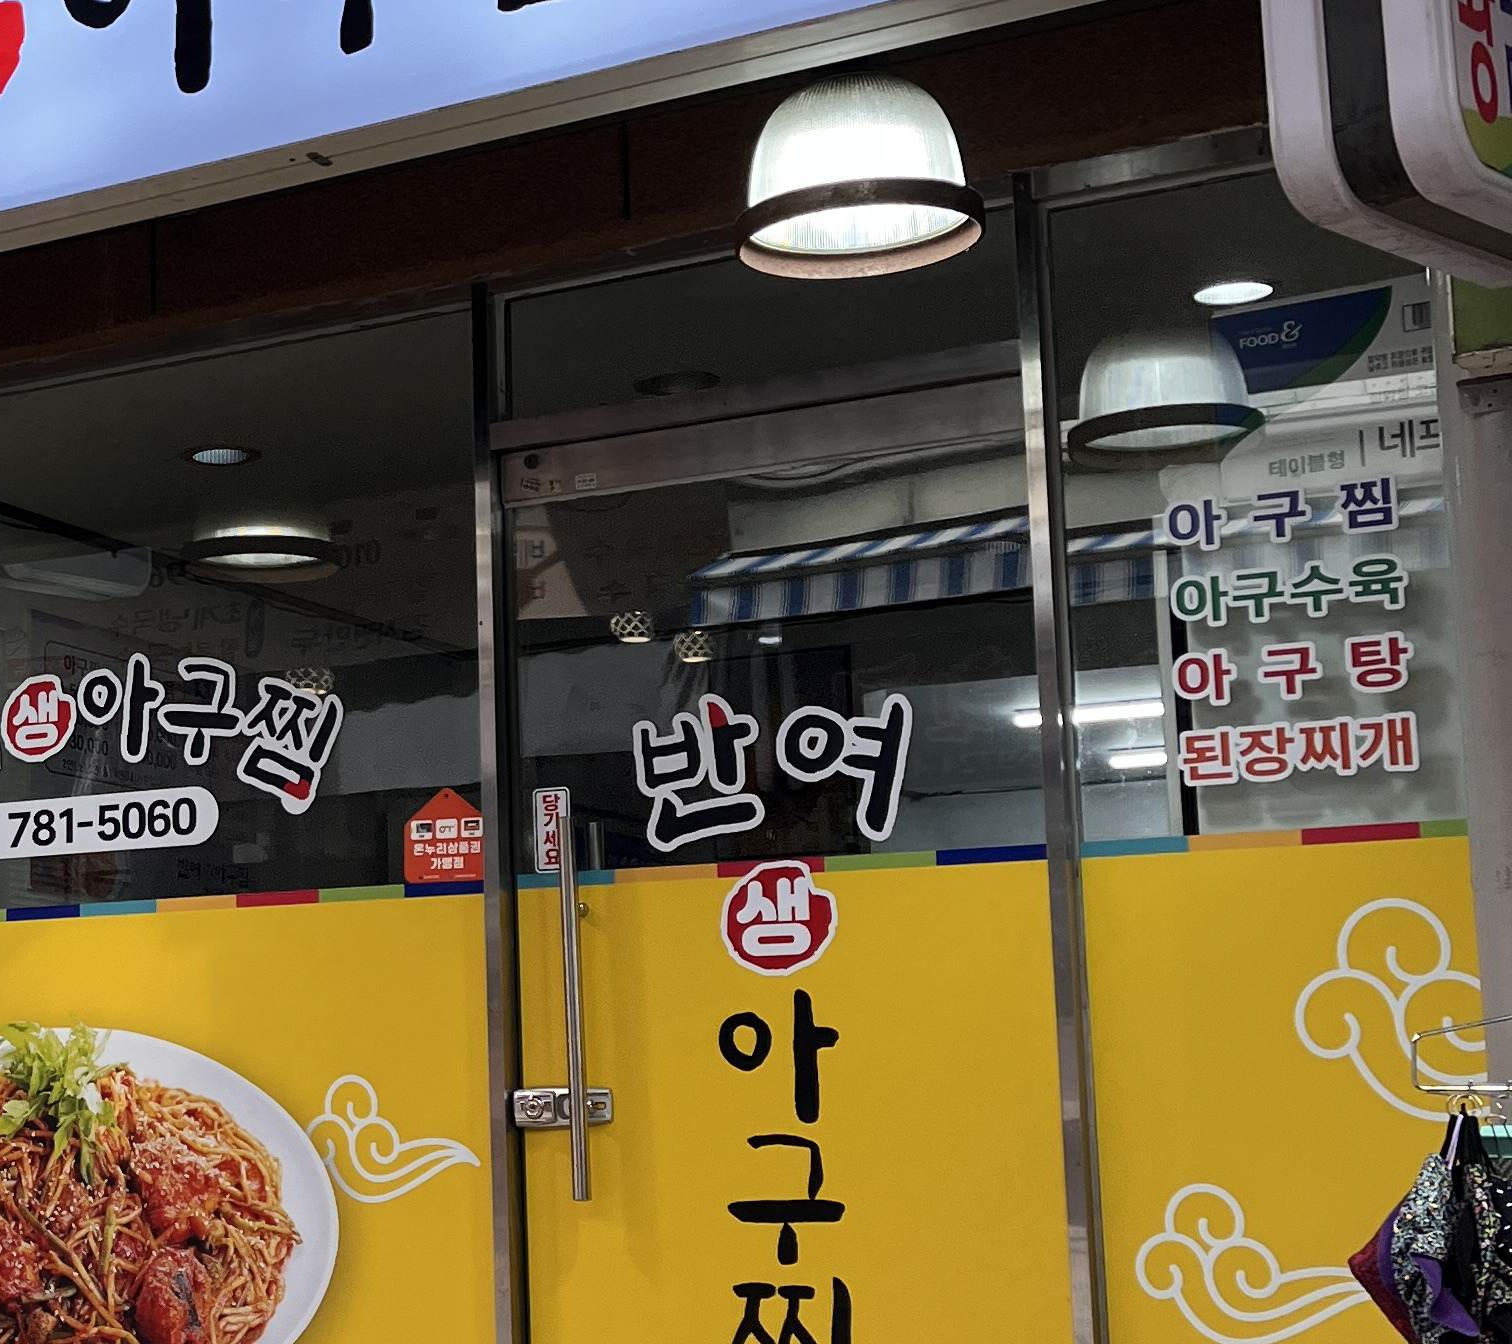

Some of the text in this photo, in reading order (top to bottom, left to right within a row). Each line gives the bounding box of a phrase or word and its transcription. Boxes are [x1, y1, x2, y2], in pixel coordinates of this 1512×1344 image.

[1174, 557, 1404, 622] 아구수육
[8, 684, 68, 754] 생
[81, 656, 340, 805] 아구찜
[1182, 716, 1414, 781] 된장찌개
[637, 696, 908, 848] 반여
[8, 798, 197, 849] 781-5060
[413, 840, 481, 856] 온누리상품권
[542, 794, 561, 865] 당기세요
[430, 856, 464, 870] 가맹점
[729, 869, 825, 965] 생
